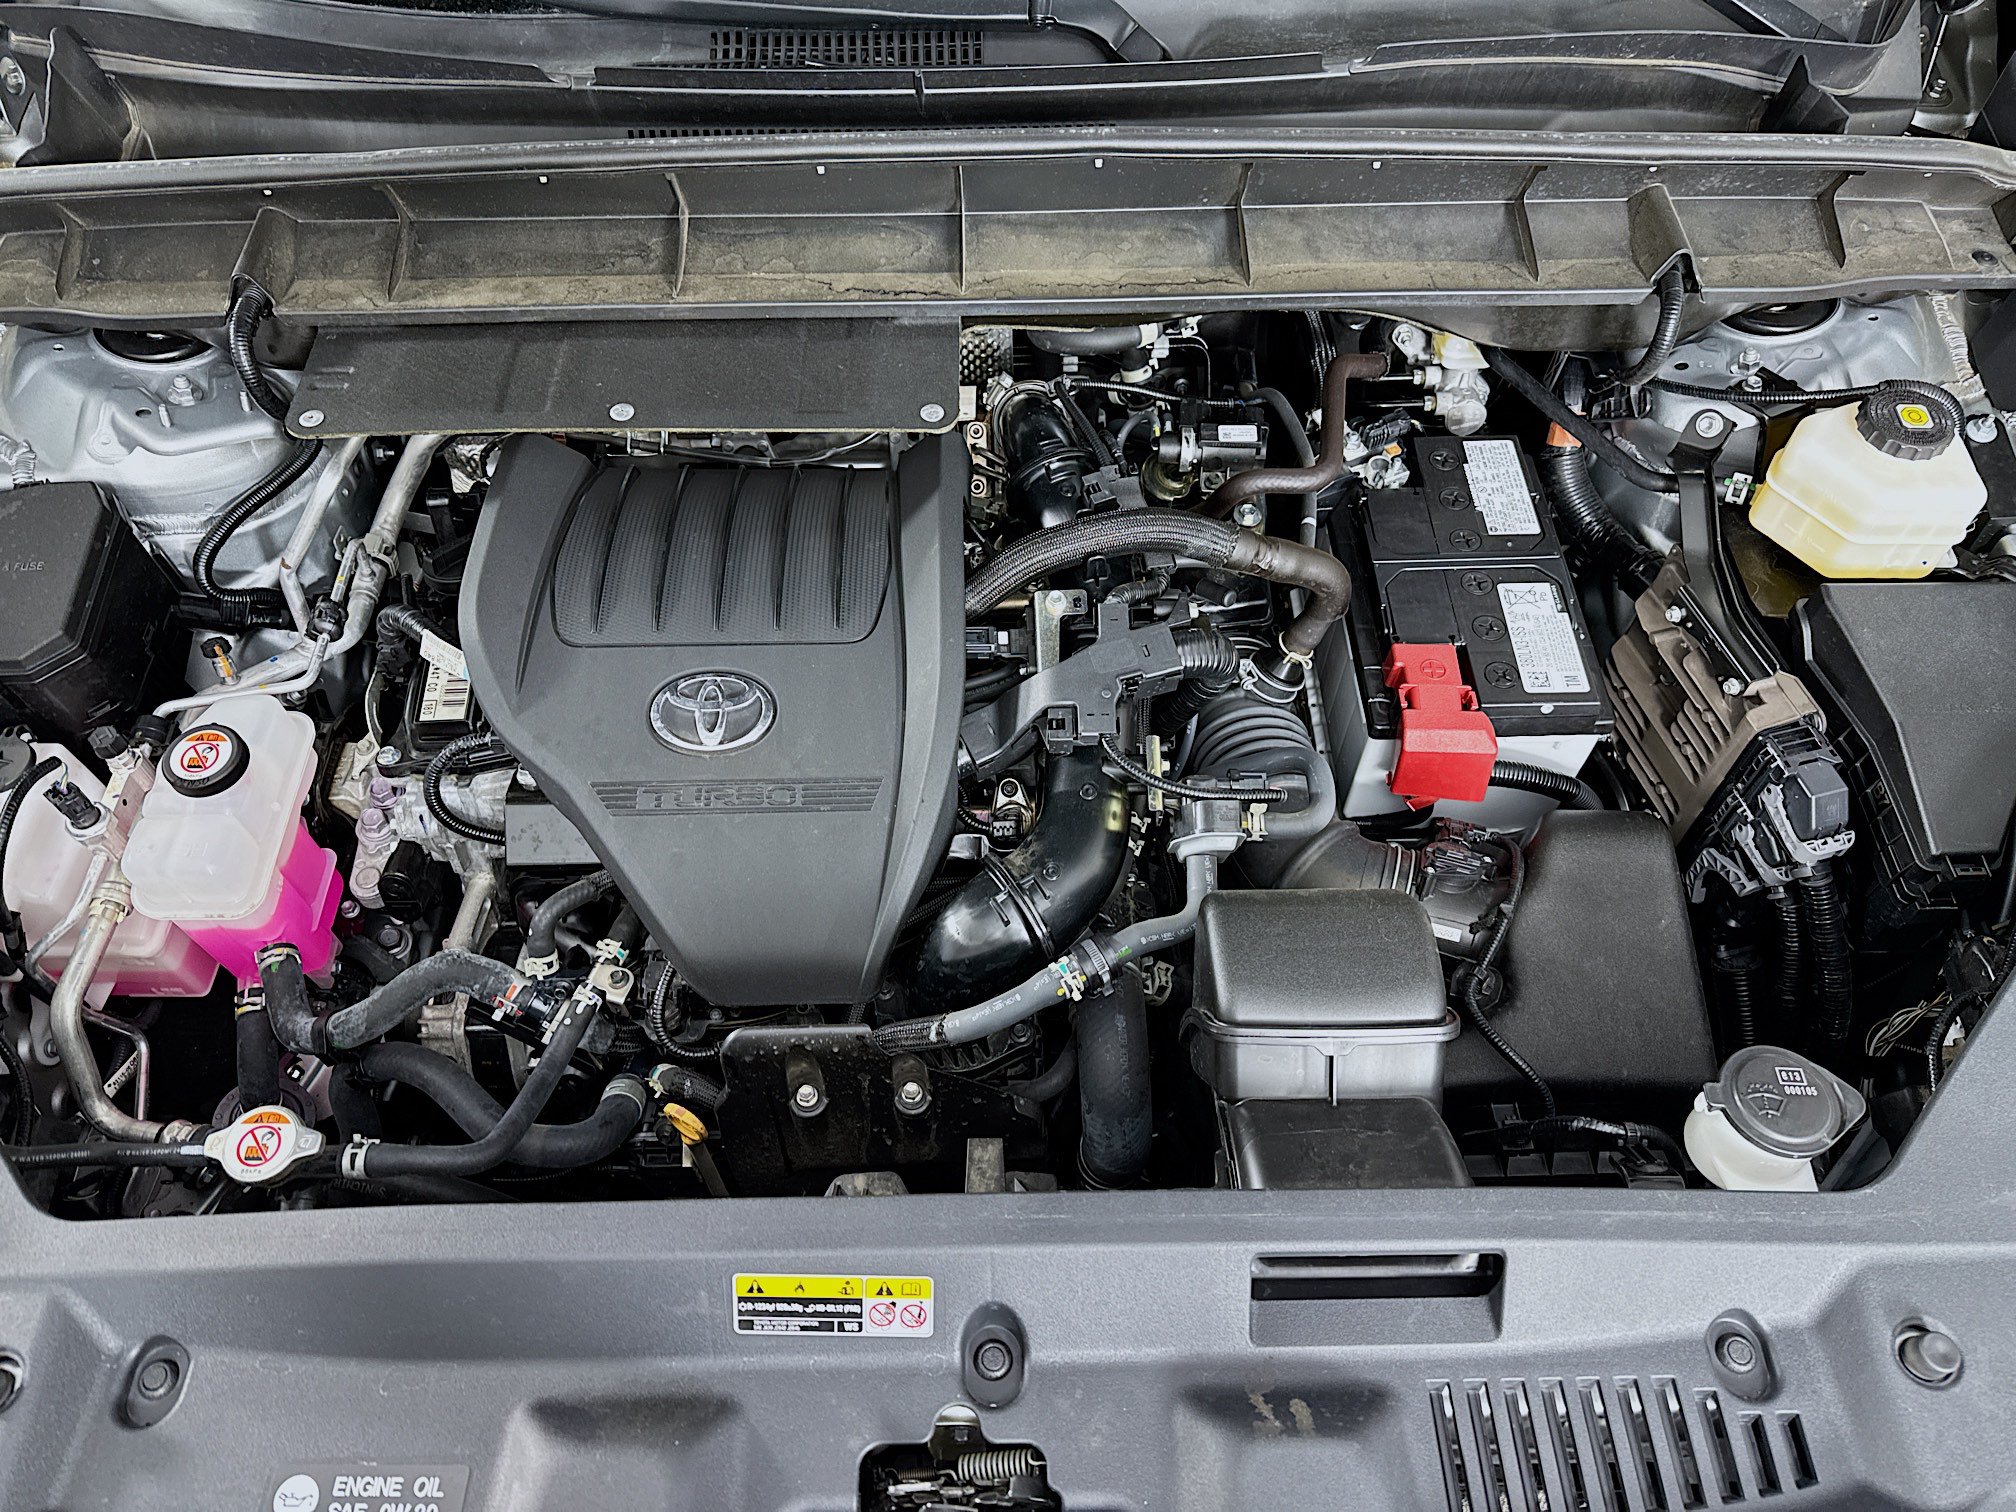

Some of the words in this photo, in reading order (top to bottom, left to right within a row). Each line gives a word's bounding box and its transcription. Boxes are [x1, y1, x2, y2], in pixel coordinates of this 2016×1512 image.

[14, 561, 45, 571] FUSE
[1563, 675, 1582, 687] TM
[422, 702, 434, 715] 180
[636, 784, 797, 808] TURBO
[1780, 1070, 1801, 1081] e13
[1784, 1085, 1818, 1096] 000105
[843, 1322, 860, 1331] WS
[332, 1476, 404, 1498] ENGINE
[413, 1476, 444, 1498] OIL
